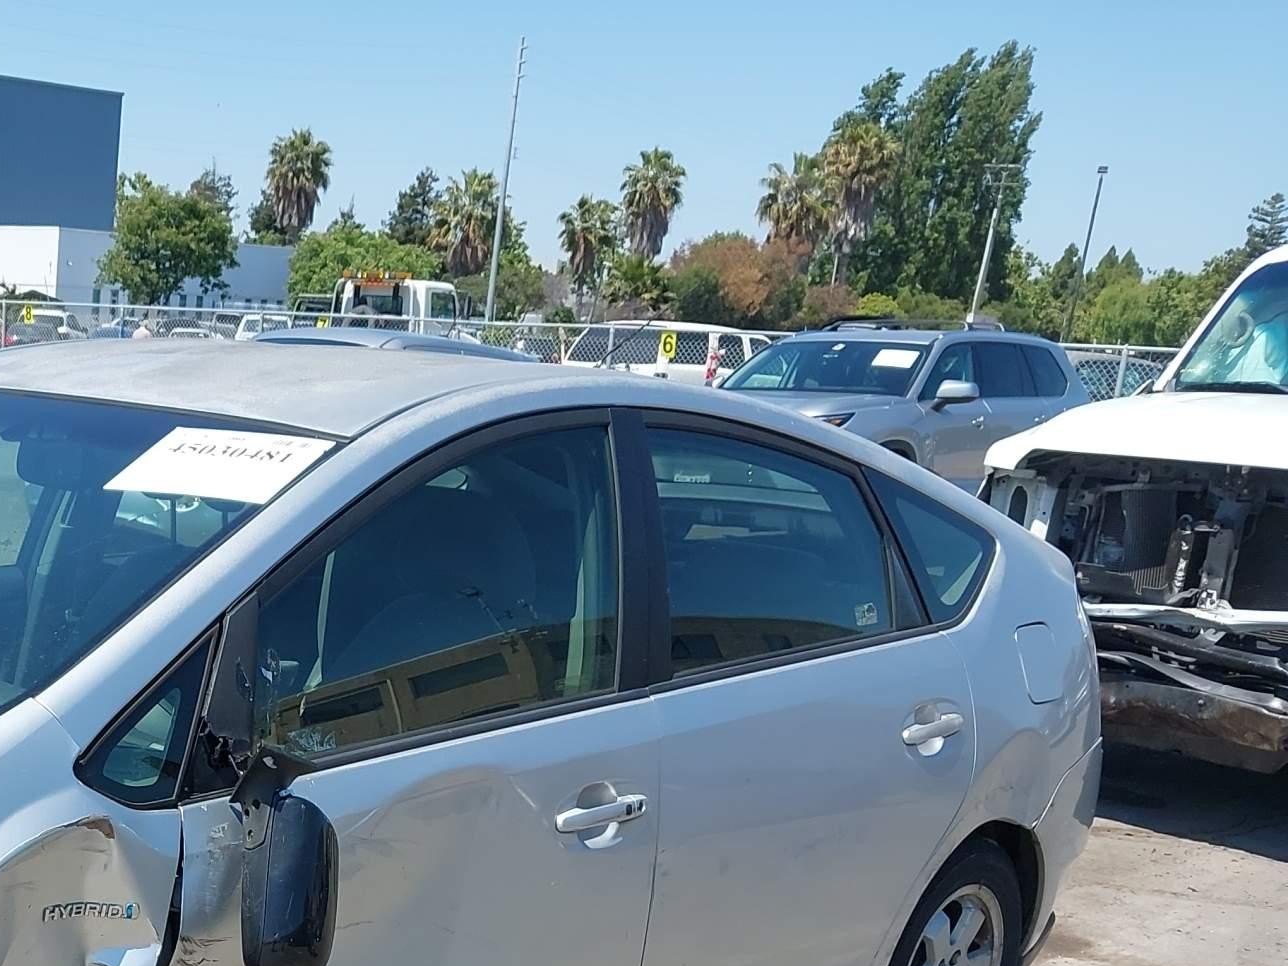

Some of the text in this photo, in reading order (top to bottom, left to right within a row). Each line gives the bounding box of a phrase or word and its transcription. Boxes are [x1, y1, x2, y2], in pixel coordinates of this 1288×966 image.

[25, 305, 32, 321] 8
[662, 334, 674, 354] 6
[42, 901, 124, 921] HYBRID
